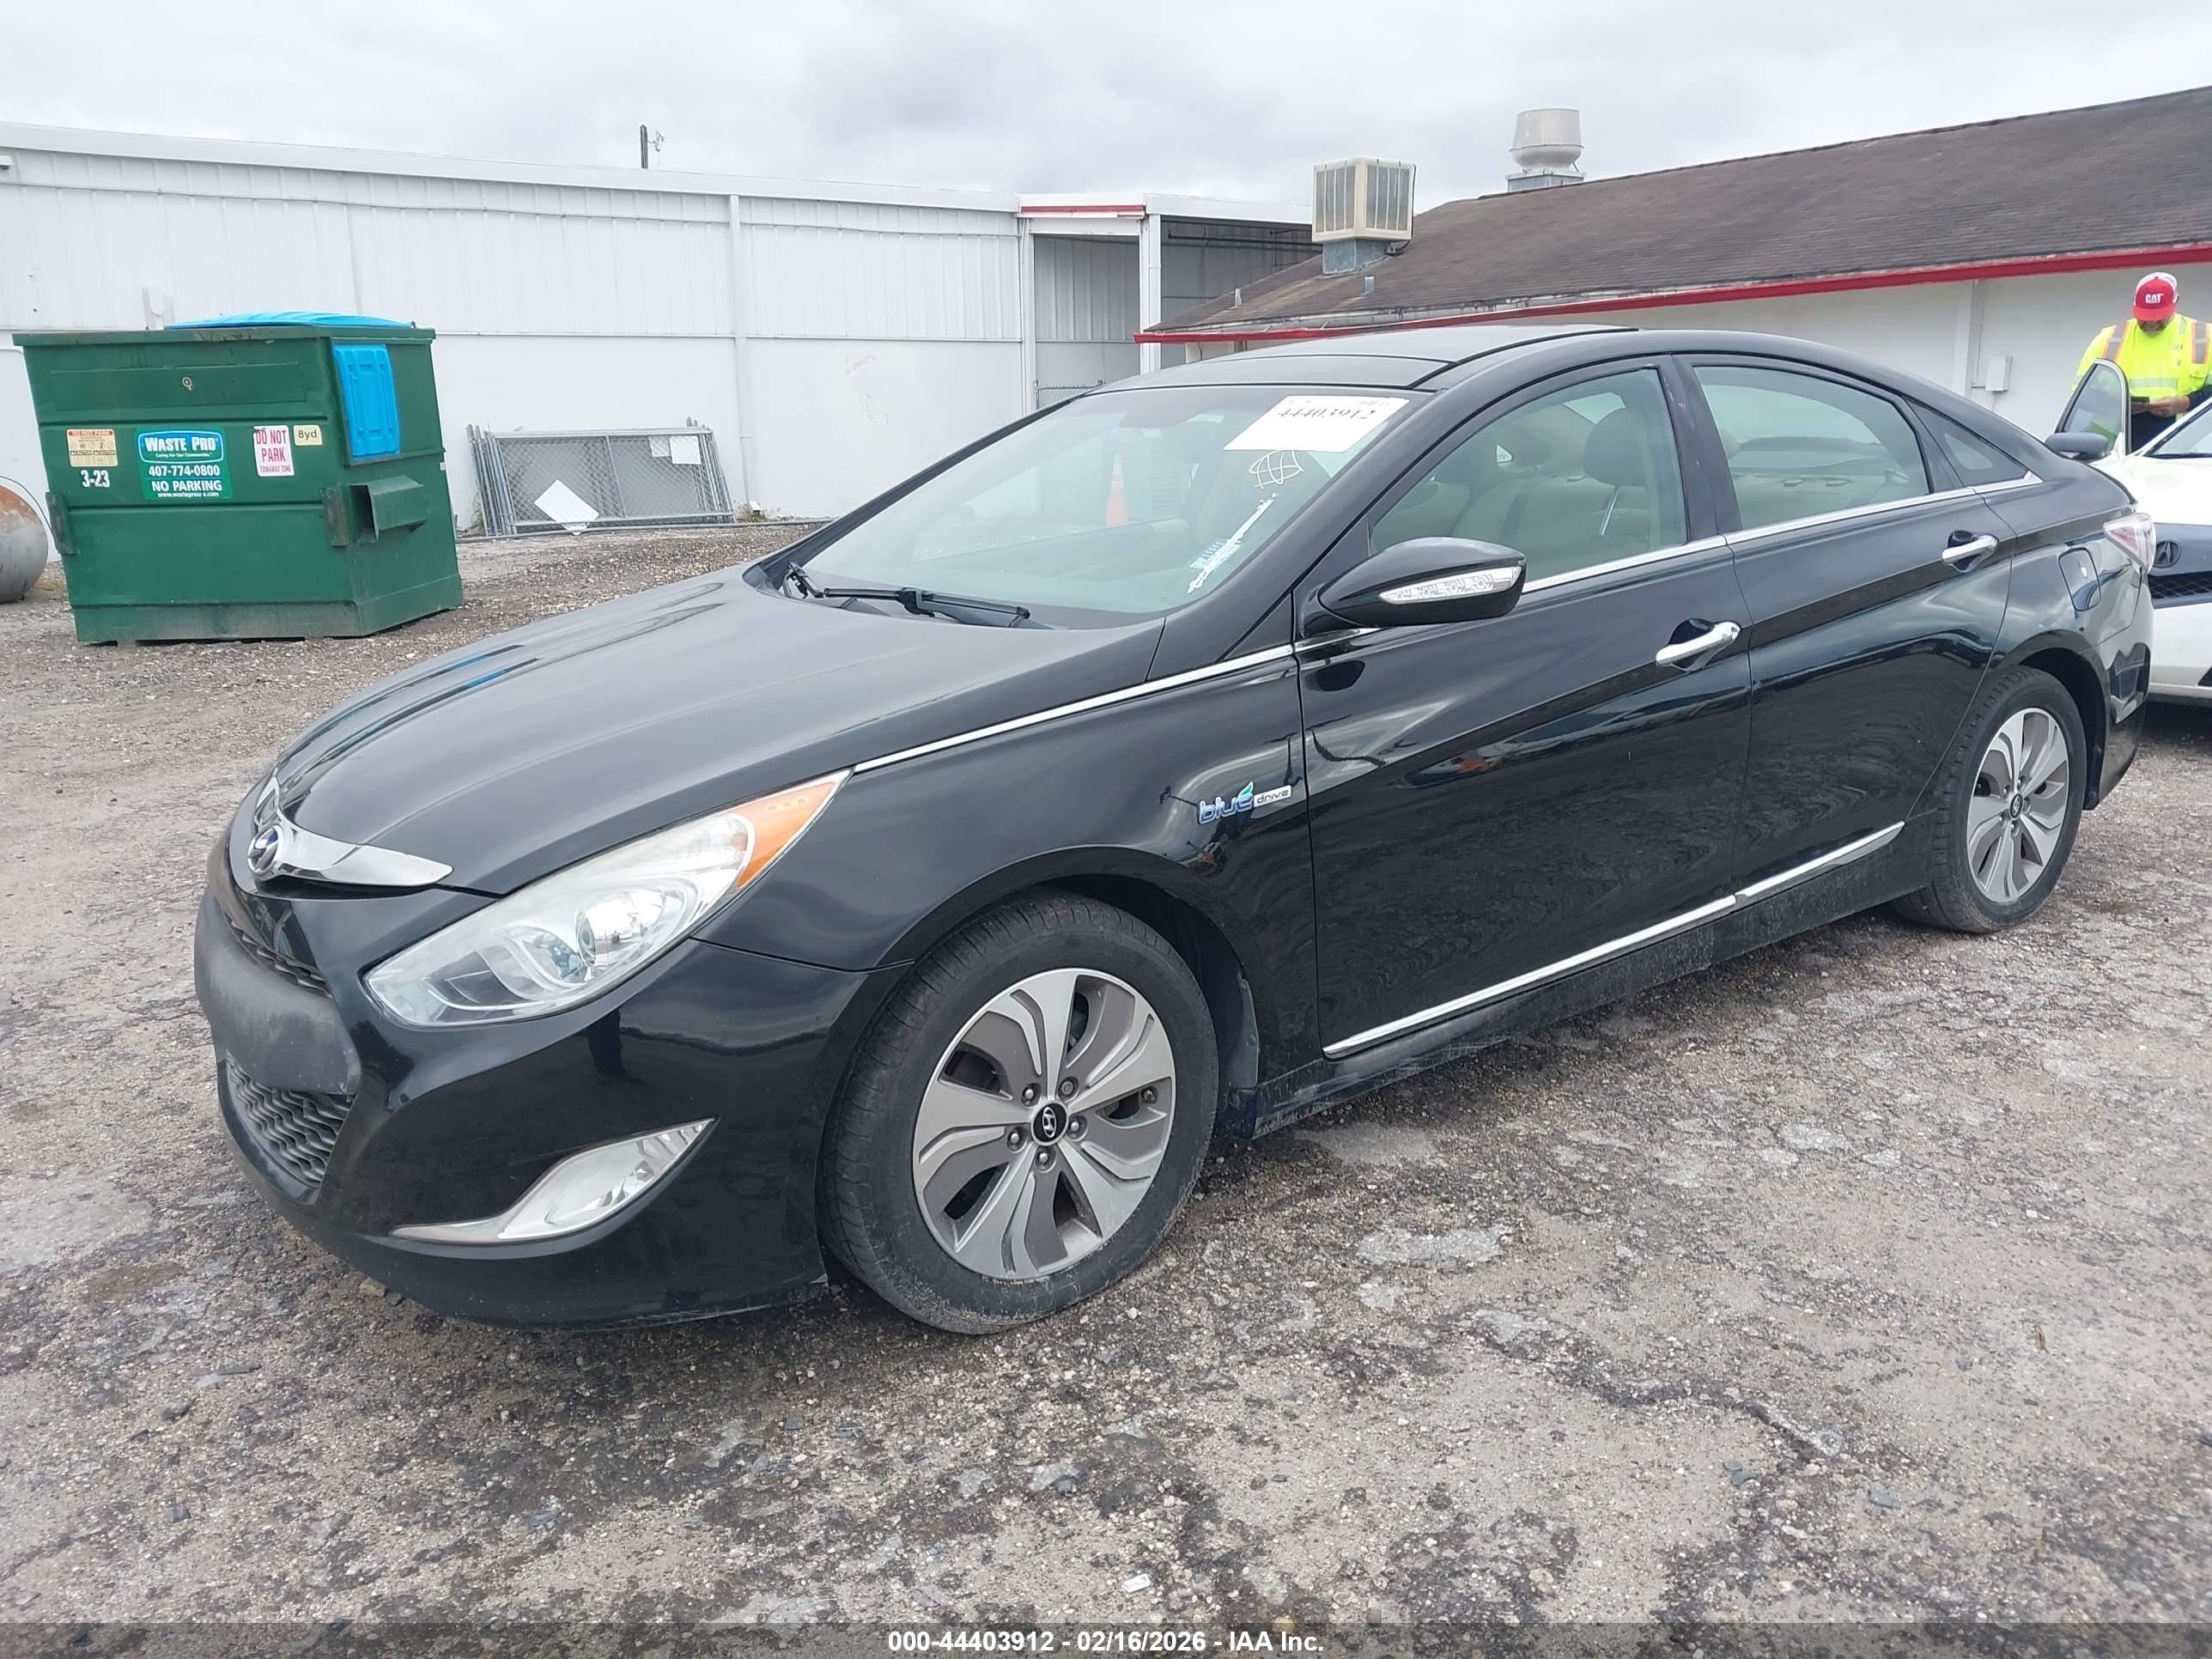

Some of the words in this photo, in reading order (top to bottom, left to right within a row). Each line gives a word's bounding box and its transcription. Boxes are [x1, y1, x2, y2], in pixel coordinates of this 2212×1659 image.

[2145, 293, 2164, 304] CAT
[256, 430, 268, 445] DO
[270, 429, 287, 445] NOT
[261, 447, 286, 462] PARK
[149, 465, 221, 477] 407-774-0800
[80, 469, 111, 488] 3-23
[151, 480, 170, 492] NO
[173, 479, 222, 492] PARKING
